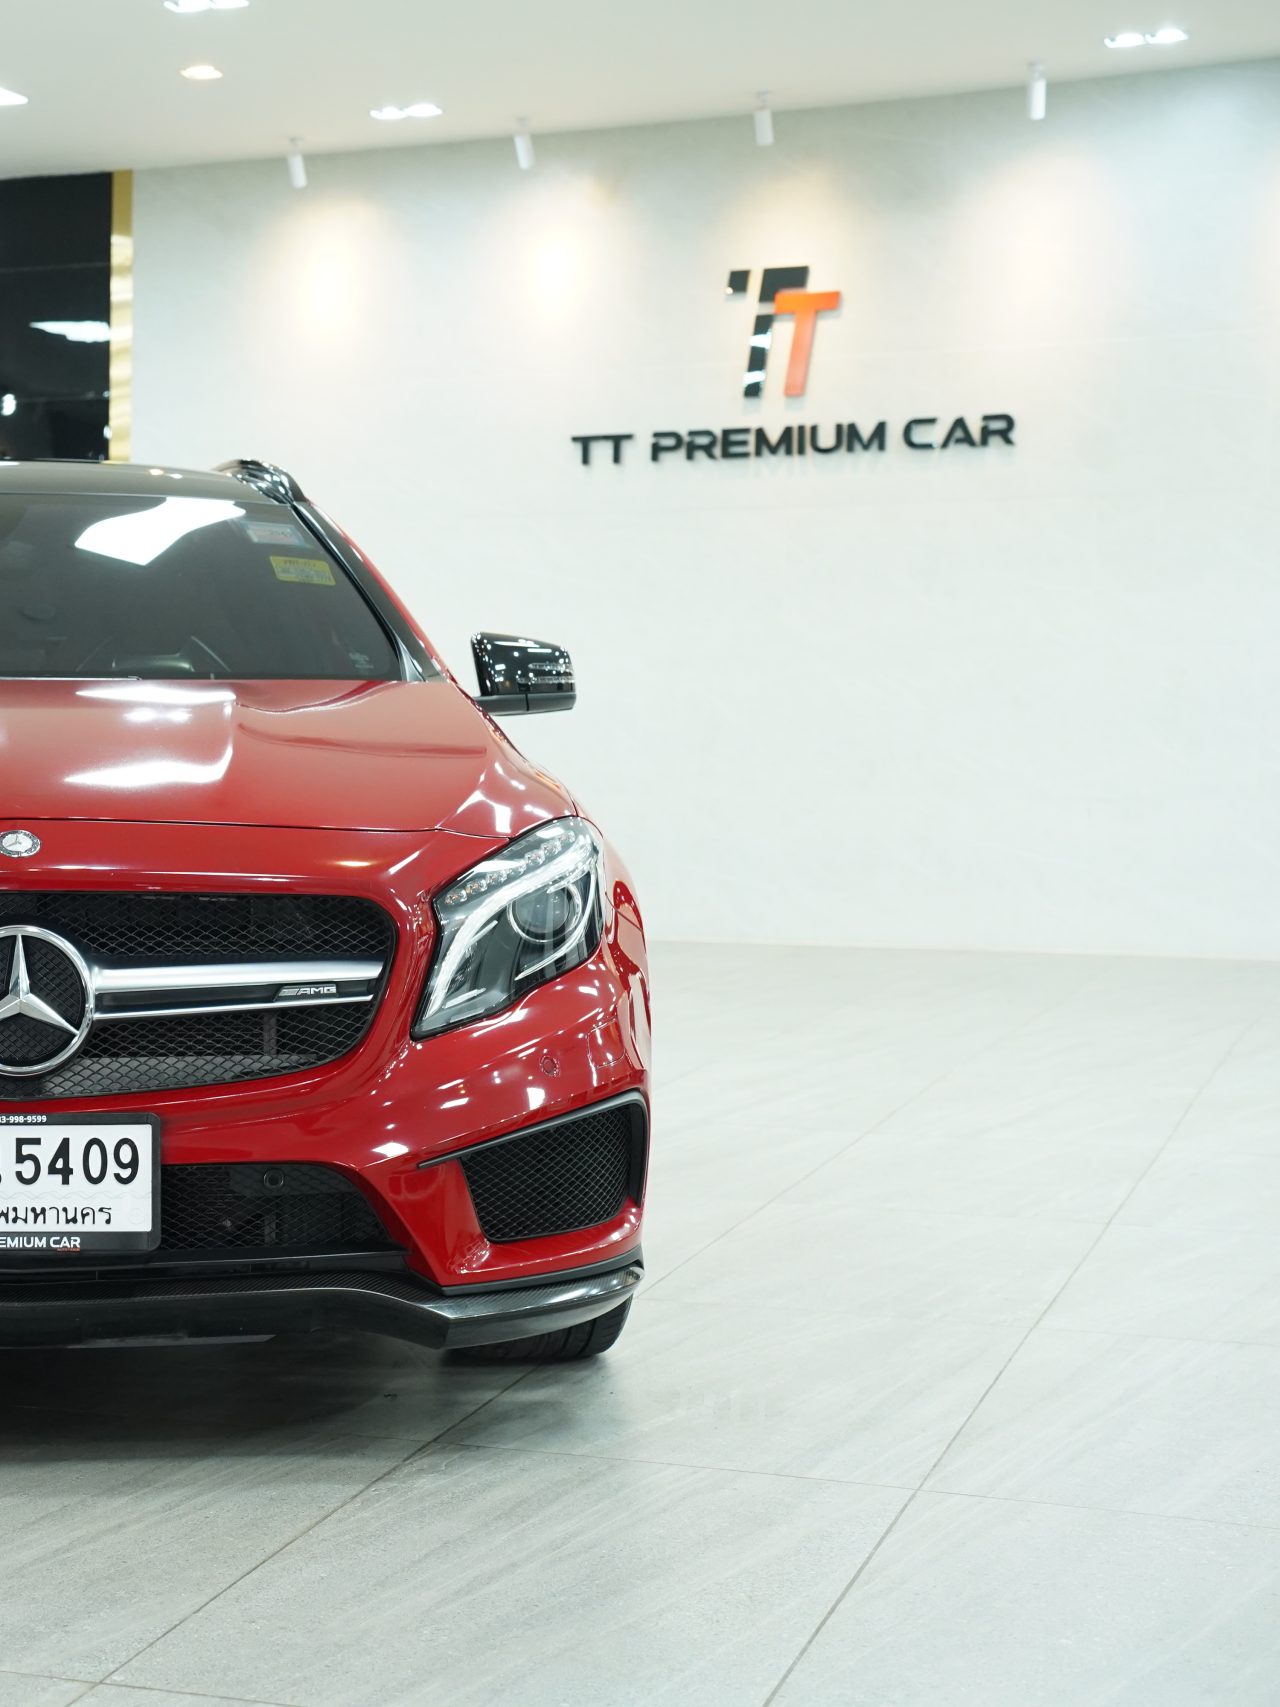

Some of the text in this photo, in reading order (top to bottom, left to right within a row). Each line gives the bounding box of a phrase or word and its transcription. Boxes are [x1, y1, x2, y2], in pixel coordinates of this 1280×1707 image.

[571, 413, 1016, 466] TT PREMIUM CAR
[297, 986, 336, 995] AMG
[15, 1137, 140, 1186] 5409
[49, 1236, 81, 1248] CAR
